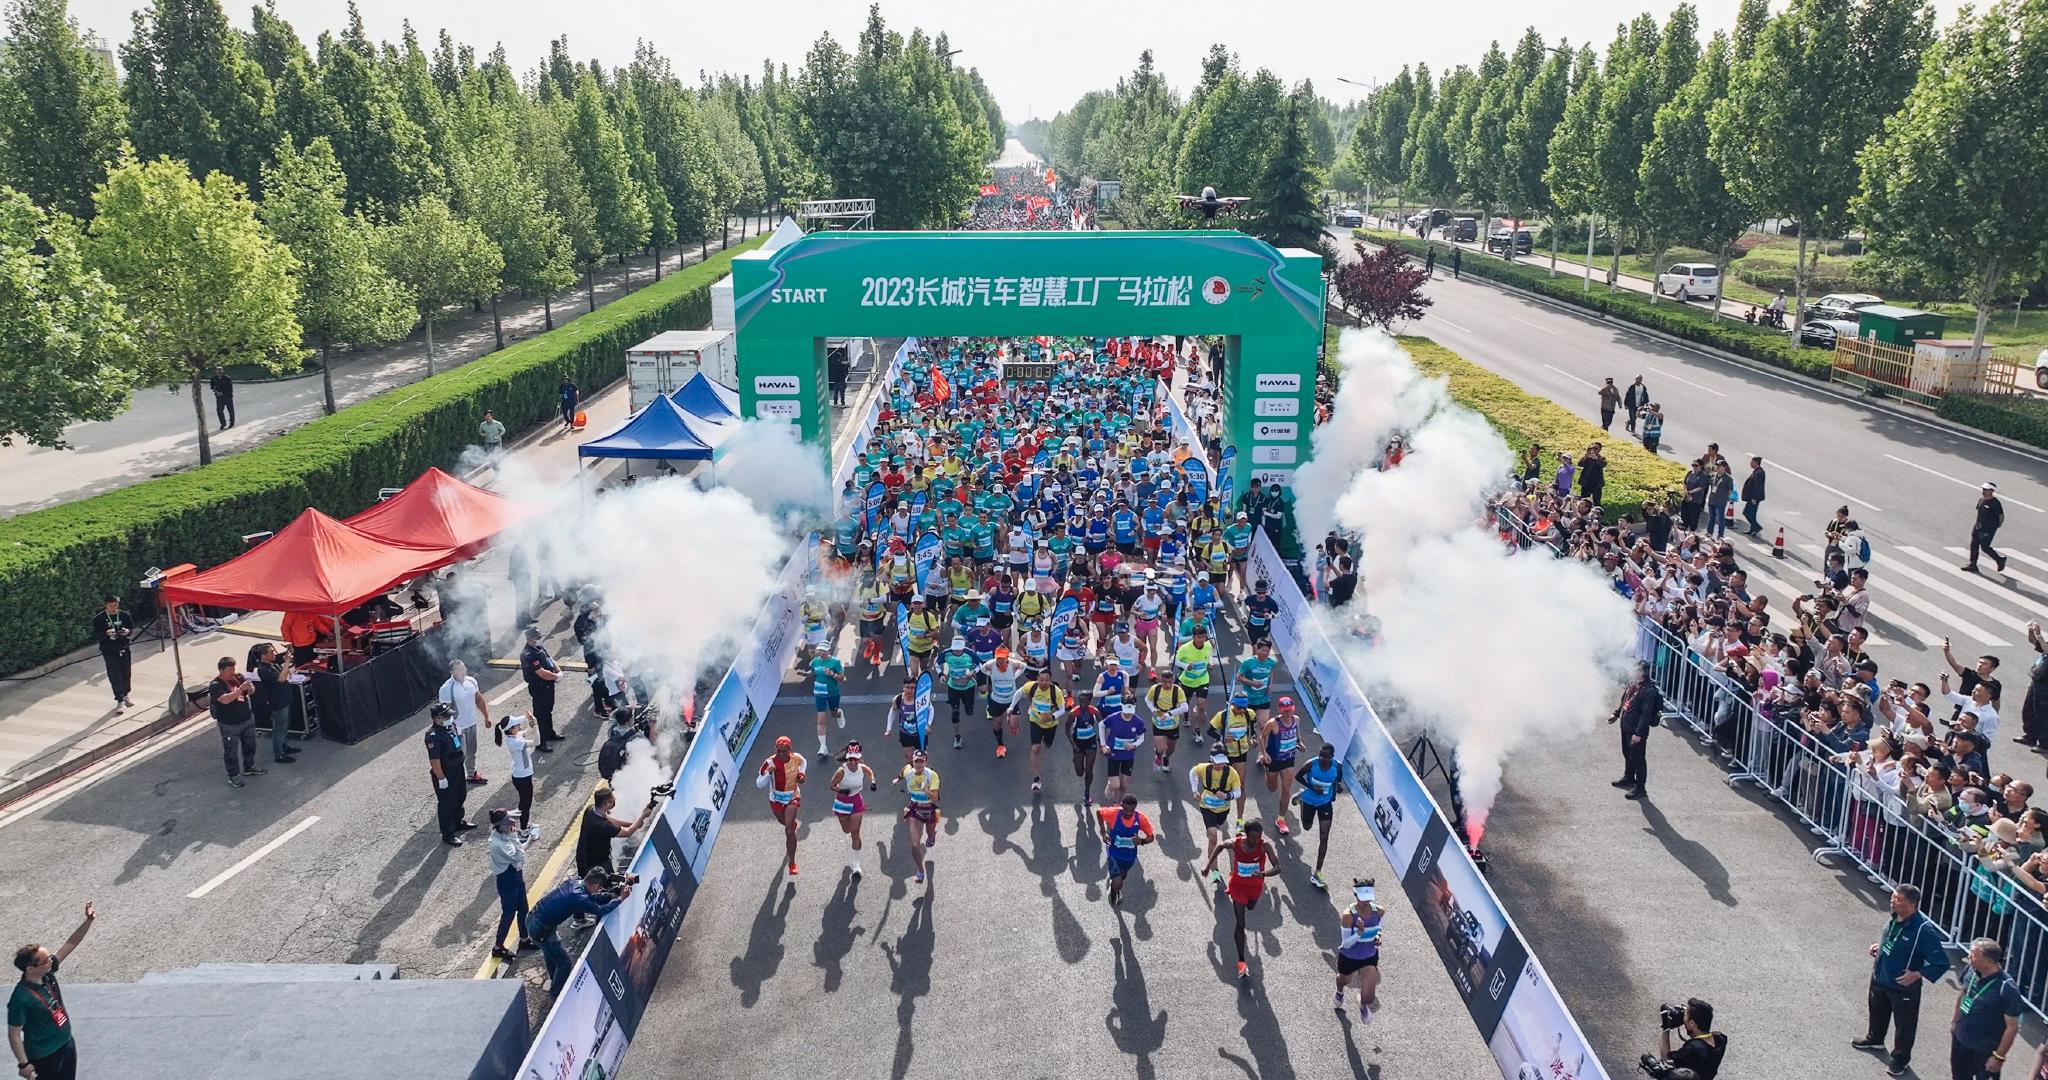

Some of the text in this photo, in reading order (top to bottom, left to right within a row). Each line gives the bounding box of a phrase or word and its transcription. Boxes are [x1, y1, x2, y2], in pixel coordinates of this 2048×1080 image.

[771, 288, 828, 304] START
[860, 276, 1193, 307] 2023长城汽车智慧工厂马拉松
[1006, 366, 1052, 378] 0:00:03
[1189, 472, 1205, 480] 5:30
